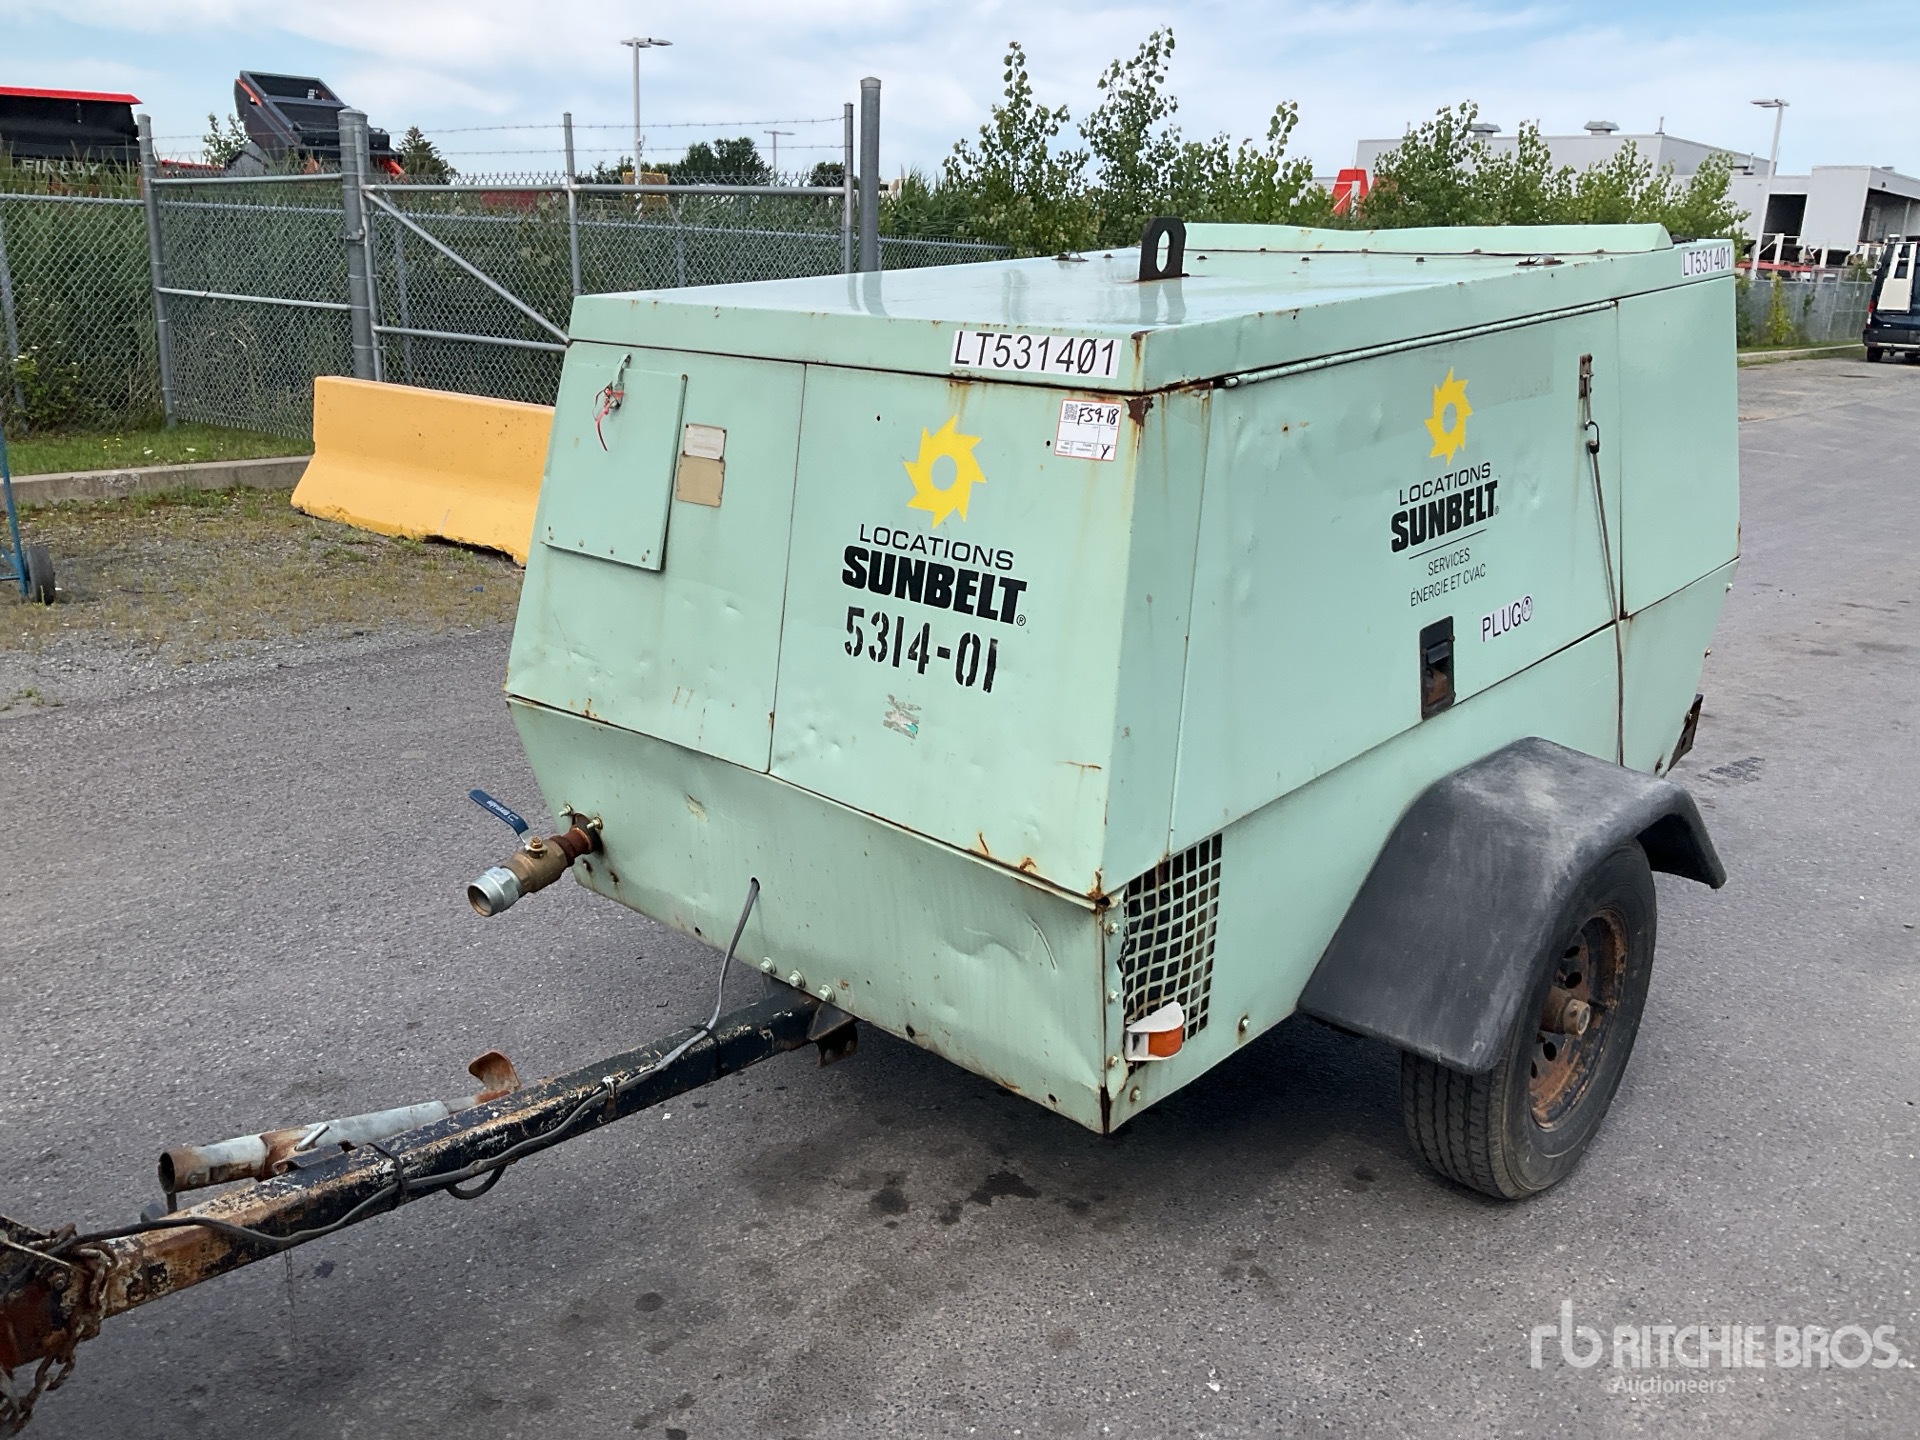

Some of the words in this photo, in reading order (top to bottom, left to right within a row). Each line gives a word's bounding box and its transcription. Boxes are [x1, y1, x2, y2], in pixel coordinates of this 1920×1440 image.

[1683, 246, 1731, 276] LT531401
[954, 330, 1117, 376] LT531401
[1398, 462, 1491, 506] LOCATIONS
[859, 523, 1015, 571] LOCATIONS
[1427, 547, 1470, 576] SERVICES
[1410, 577, 1449, 607] ÉNERGIE
[1450, 572, 1461, 592] ET
[1463, 563, 1487, 587] CVAC
[843, 606, 999, 694] 5314-01
